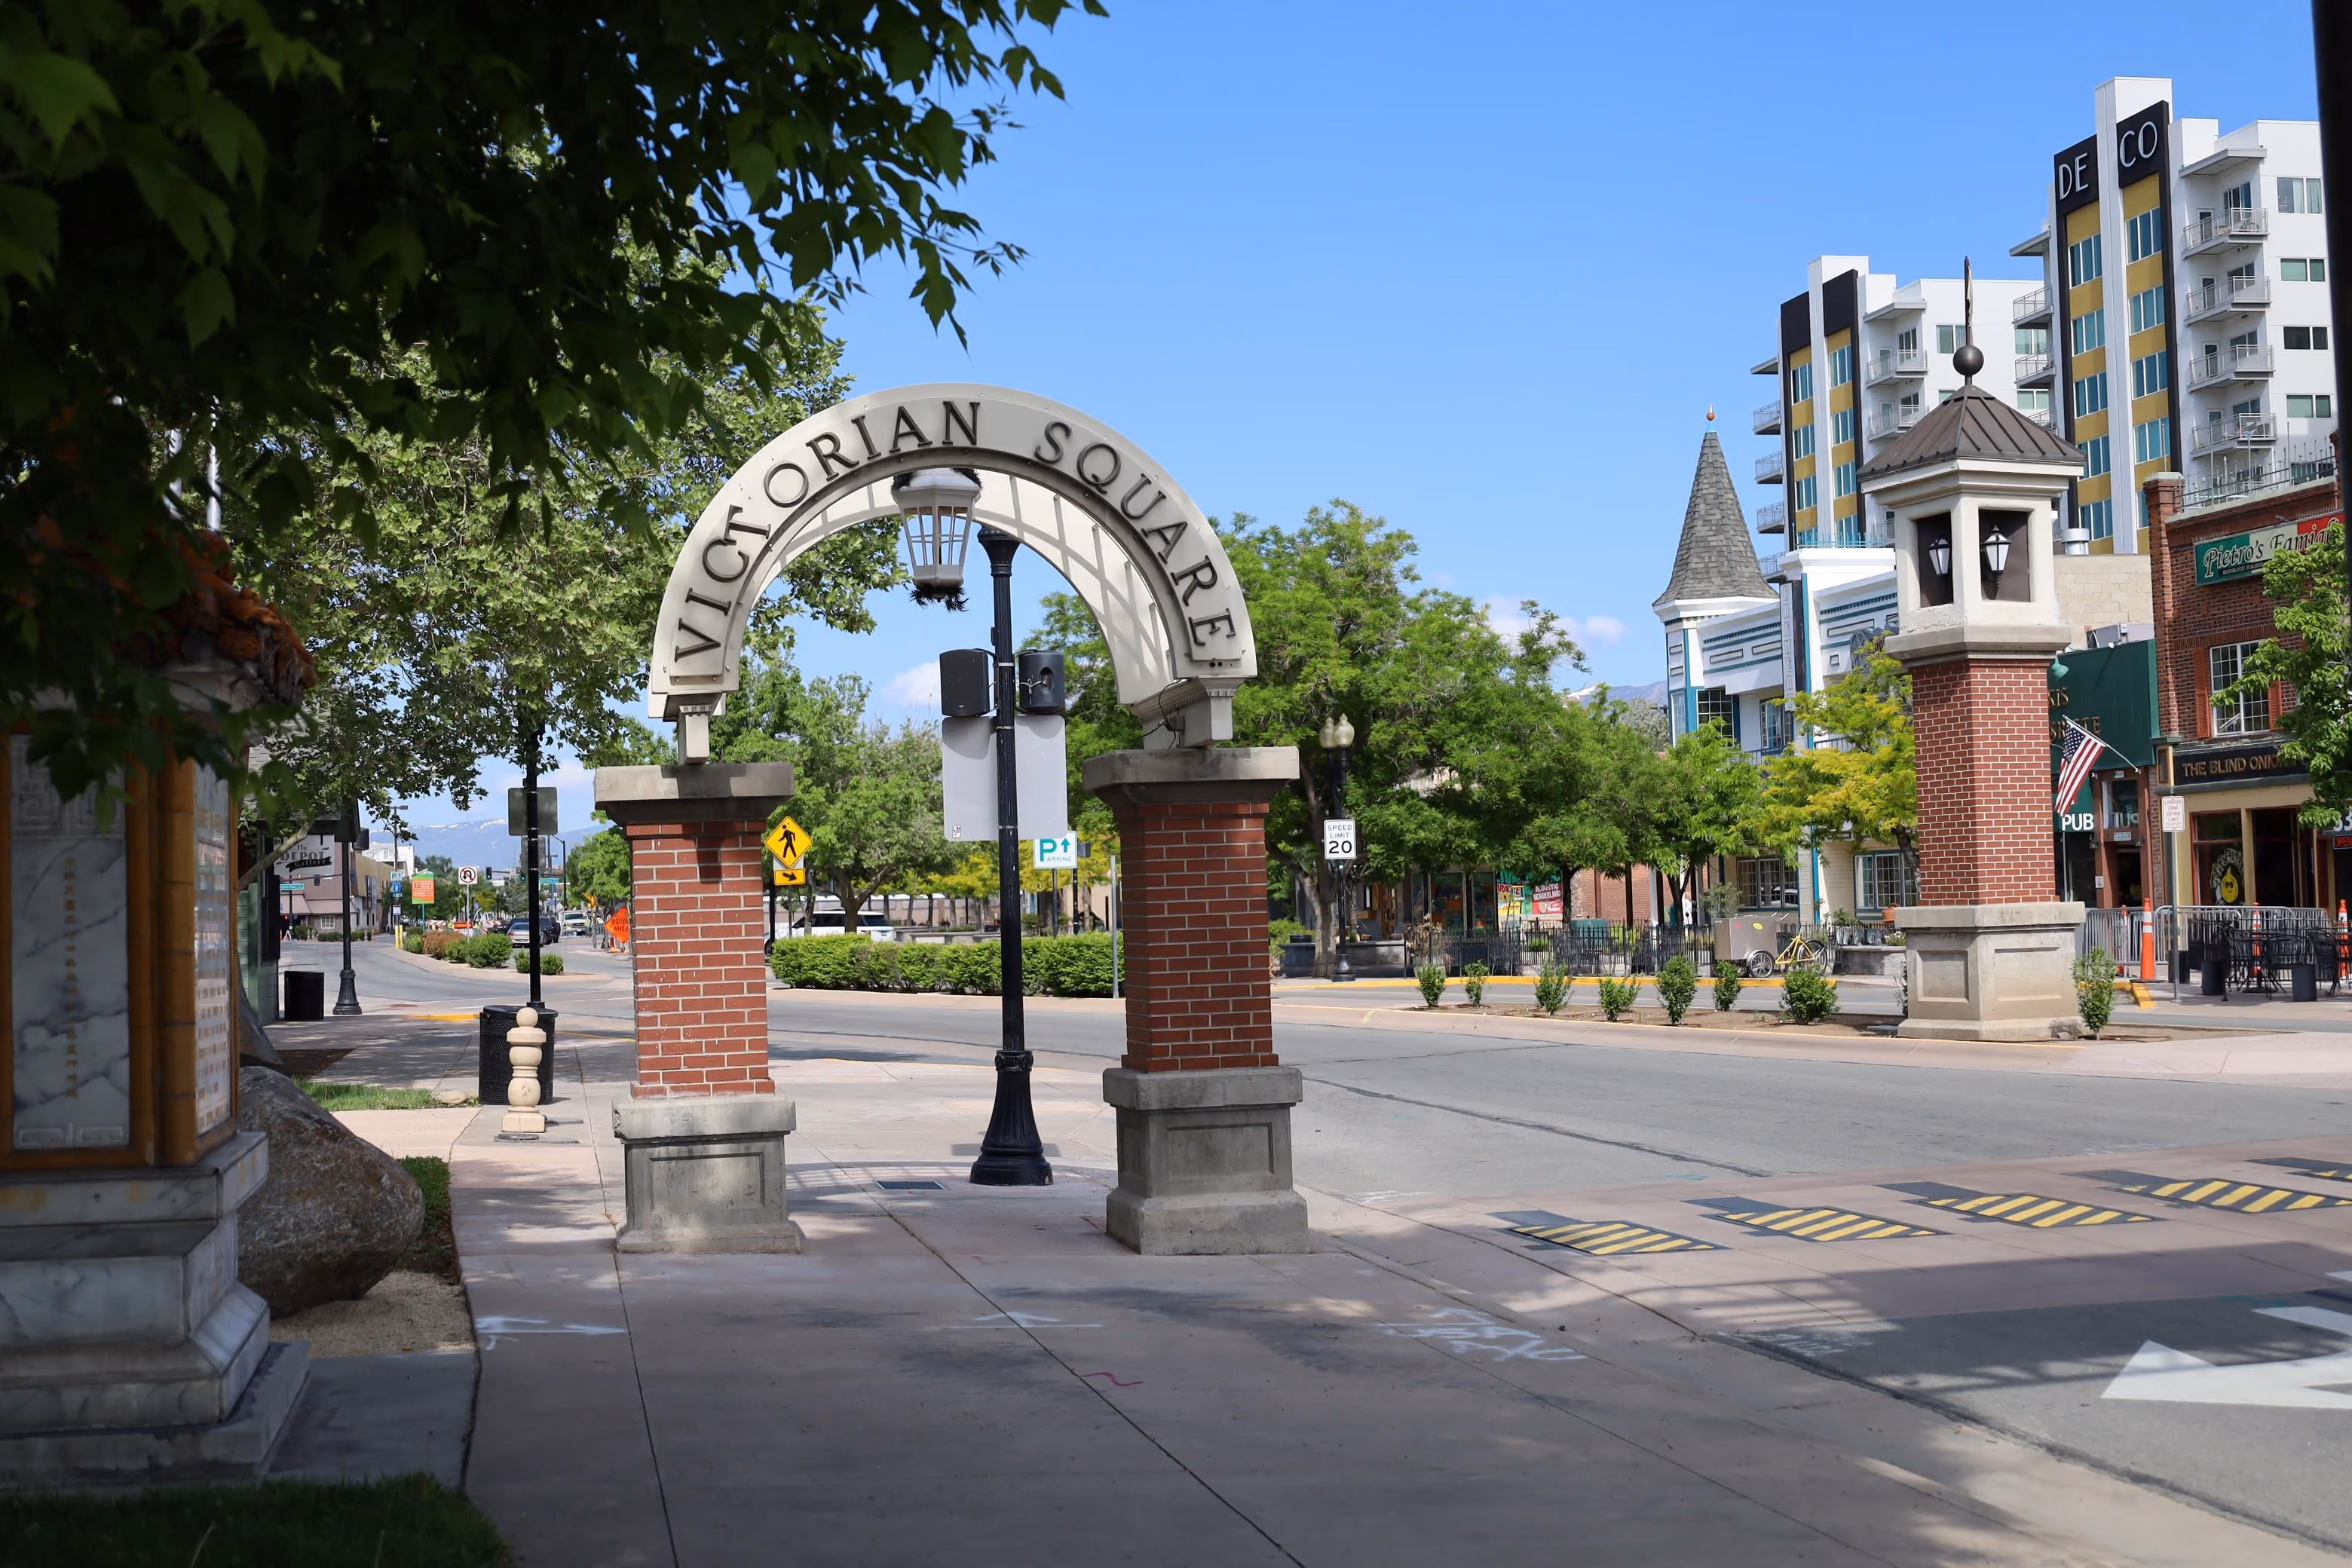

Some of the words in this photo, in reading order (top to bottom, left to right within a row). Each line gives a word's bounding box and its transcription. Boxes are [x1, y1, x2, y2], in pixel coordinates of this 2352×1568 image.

[2058, 152, 2089, 200] DE
[2119, 121, 2158, 167] CO
[673, 400, 981, 663] VICTORIAN
[1034, 420, 1238, 647] SQUARE
[2204, 541, 2264, 579] Pietro's
[2182, 761, 2207, 776] THE
[2210, 758, 2246, 774] BLIND
[2063, 813, 2094, 831] PUB
[280, 851, 325, 861] DEPOT
[1328, 841, 1352, 853] 20
